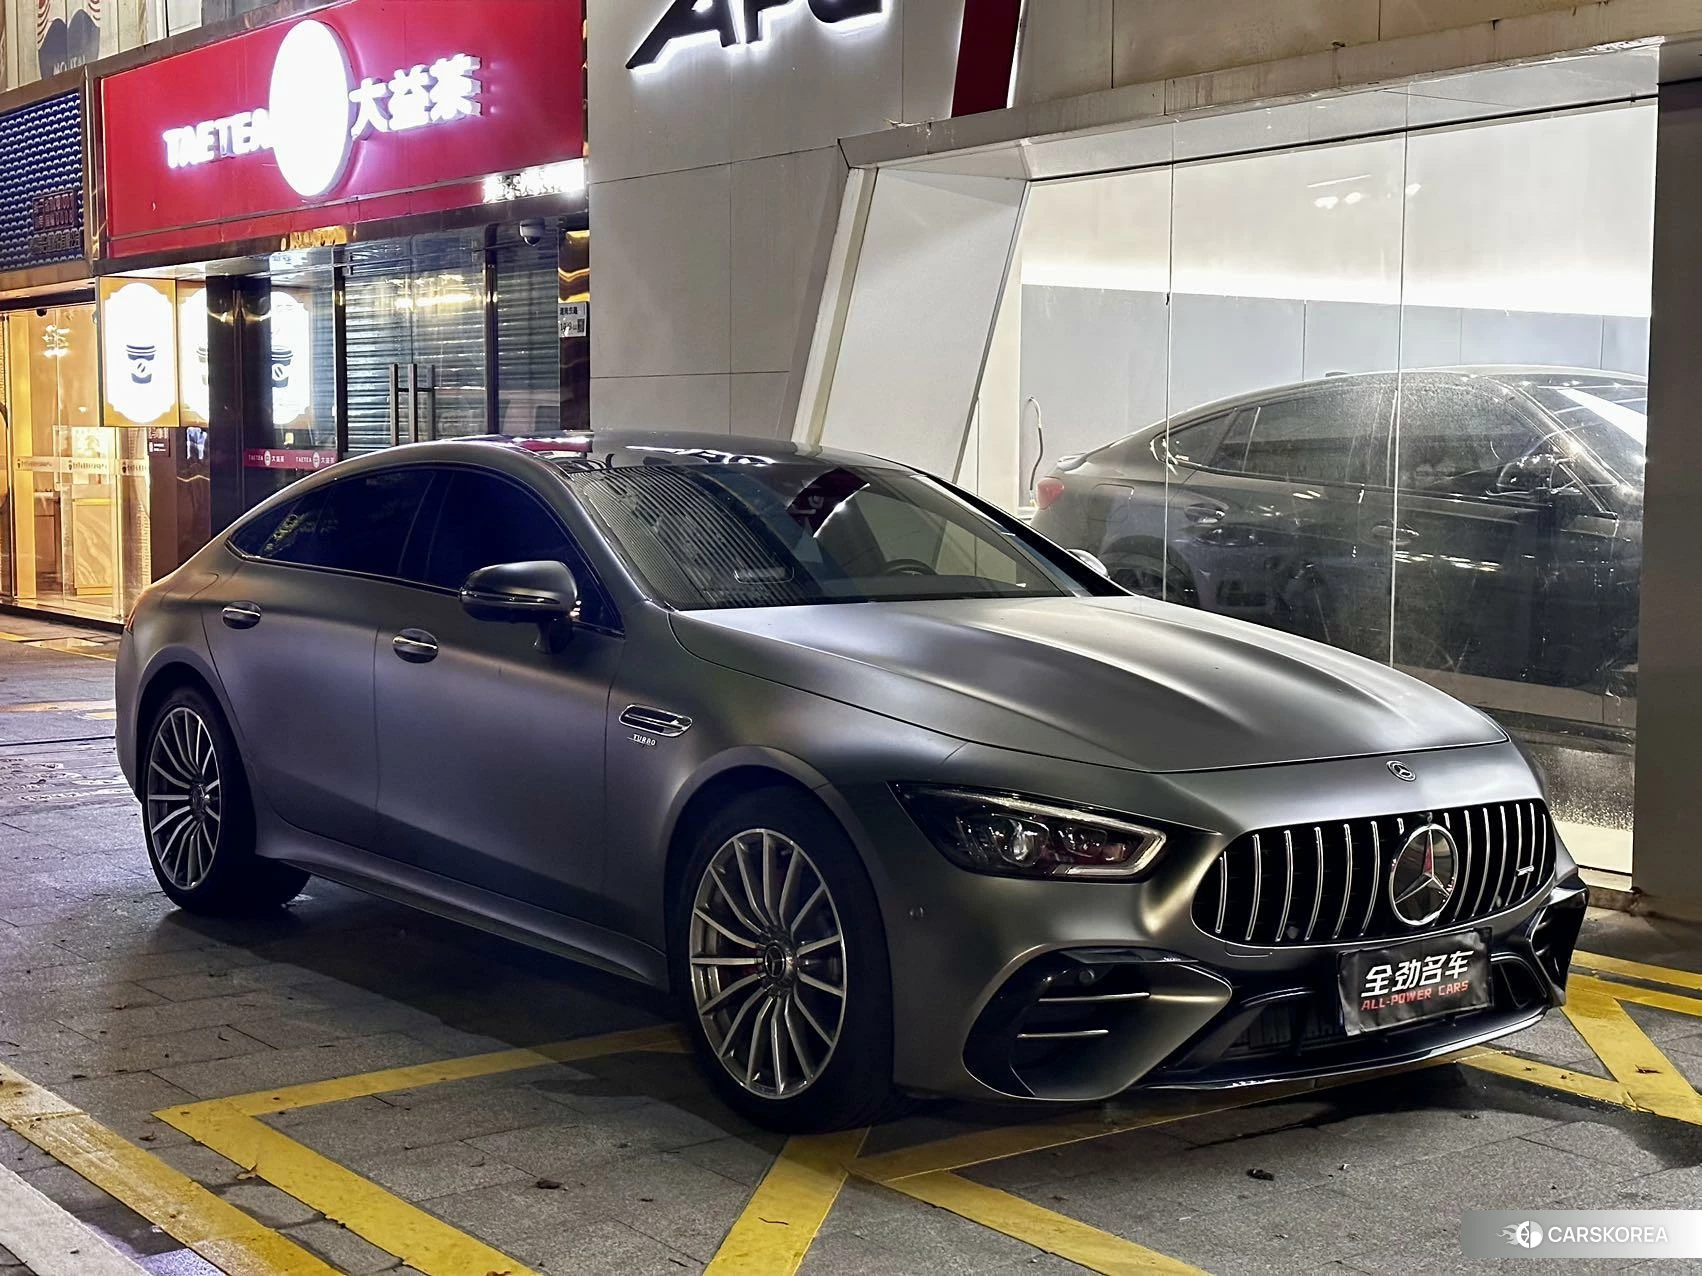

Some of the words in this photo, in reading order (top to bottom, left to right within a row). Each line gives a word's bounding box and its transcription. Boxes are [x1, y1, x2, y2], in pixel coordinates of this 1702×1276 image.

[348, 53, 477, 140] 大益茶
[162, 108, 273, 168] TAETEA
[633, 733, 656, 746] TURBO
[1361, 950, 1474, 997] 全劲名车
[1361, 988, 1432, 1010] ALL-POWER
[1438, 980, 1469, 996] CARS
